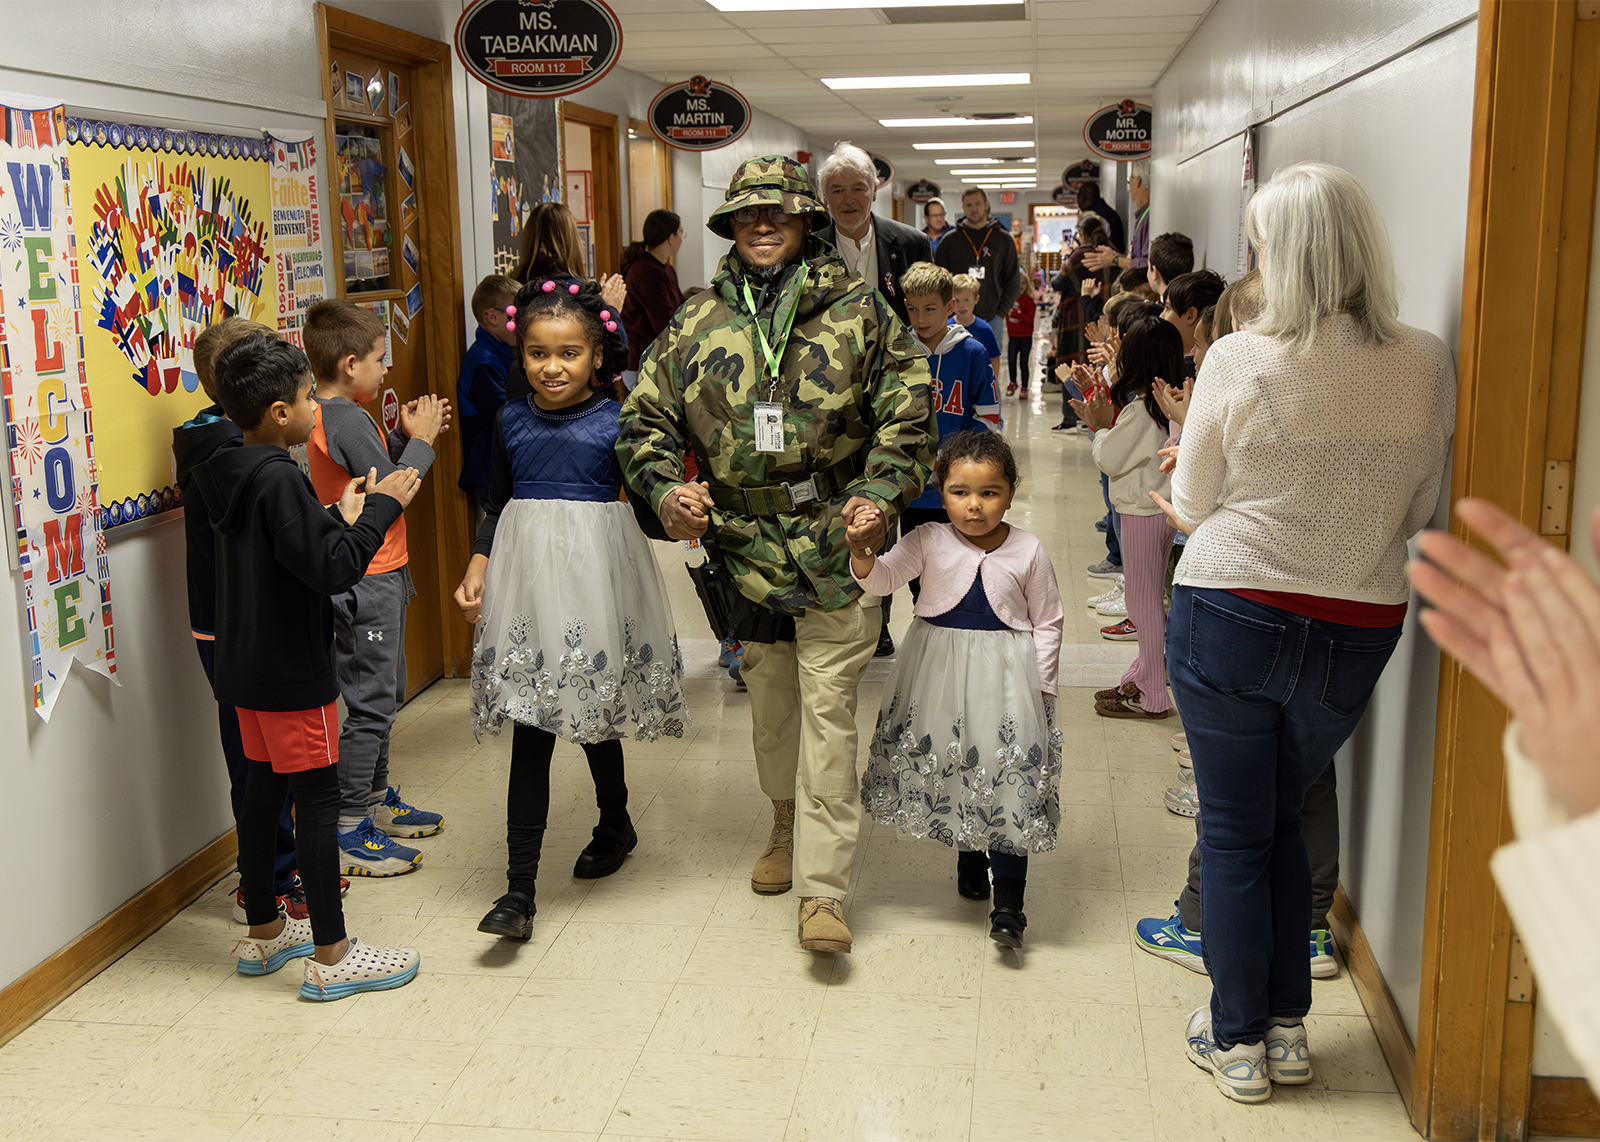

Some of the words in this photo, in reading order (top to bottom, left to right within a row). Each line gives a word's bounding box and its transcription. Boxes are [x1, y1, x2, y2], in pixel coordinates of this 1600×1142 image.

[519, 11, 558, 30] MS.
[480, 34, 598, 54] TABAKMAN
[511, 63, 545, 74] ROOM
[547, 63, 566, 73] 112
[686, 98, 711, 111] MS.
[673, 112, 725, 125] MARTIN
[1115, 118, 1138, 129] MR.
[1105, 129, 1148, 140] MOTTO
[271, 177, 309, 207] Fáilte
[273, 209, 305, 222] BENVENUTA
[308, 175, 320, 243] WELINA
[276, 252, 286, 314] YOKOSO
[6, 161, 88, 652] WELCOME
[385, 402, 396, 421] STOP
